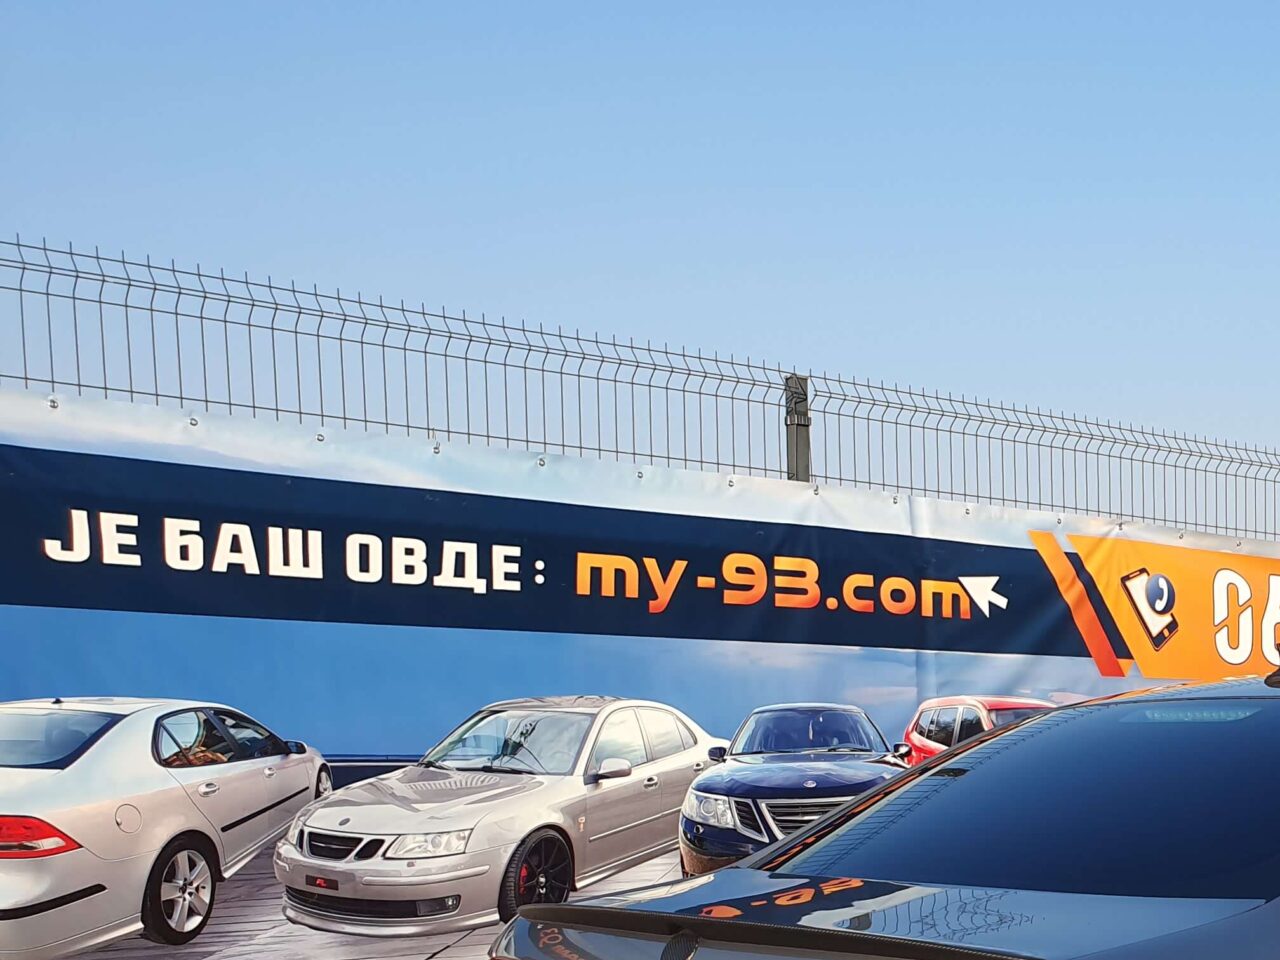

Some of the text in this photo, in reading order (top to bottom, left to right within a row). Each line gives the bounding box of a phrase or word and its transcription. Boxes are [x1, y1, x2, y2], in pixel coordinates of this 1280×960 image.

[43, 509, 142, 567] ЈЕ
[163, 516, 323, 580] БАШ
[576, 551, 971, 620] my-93.com
